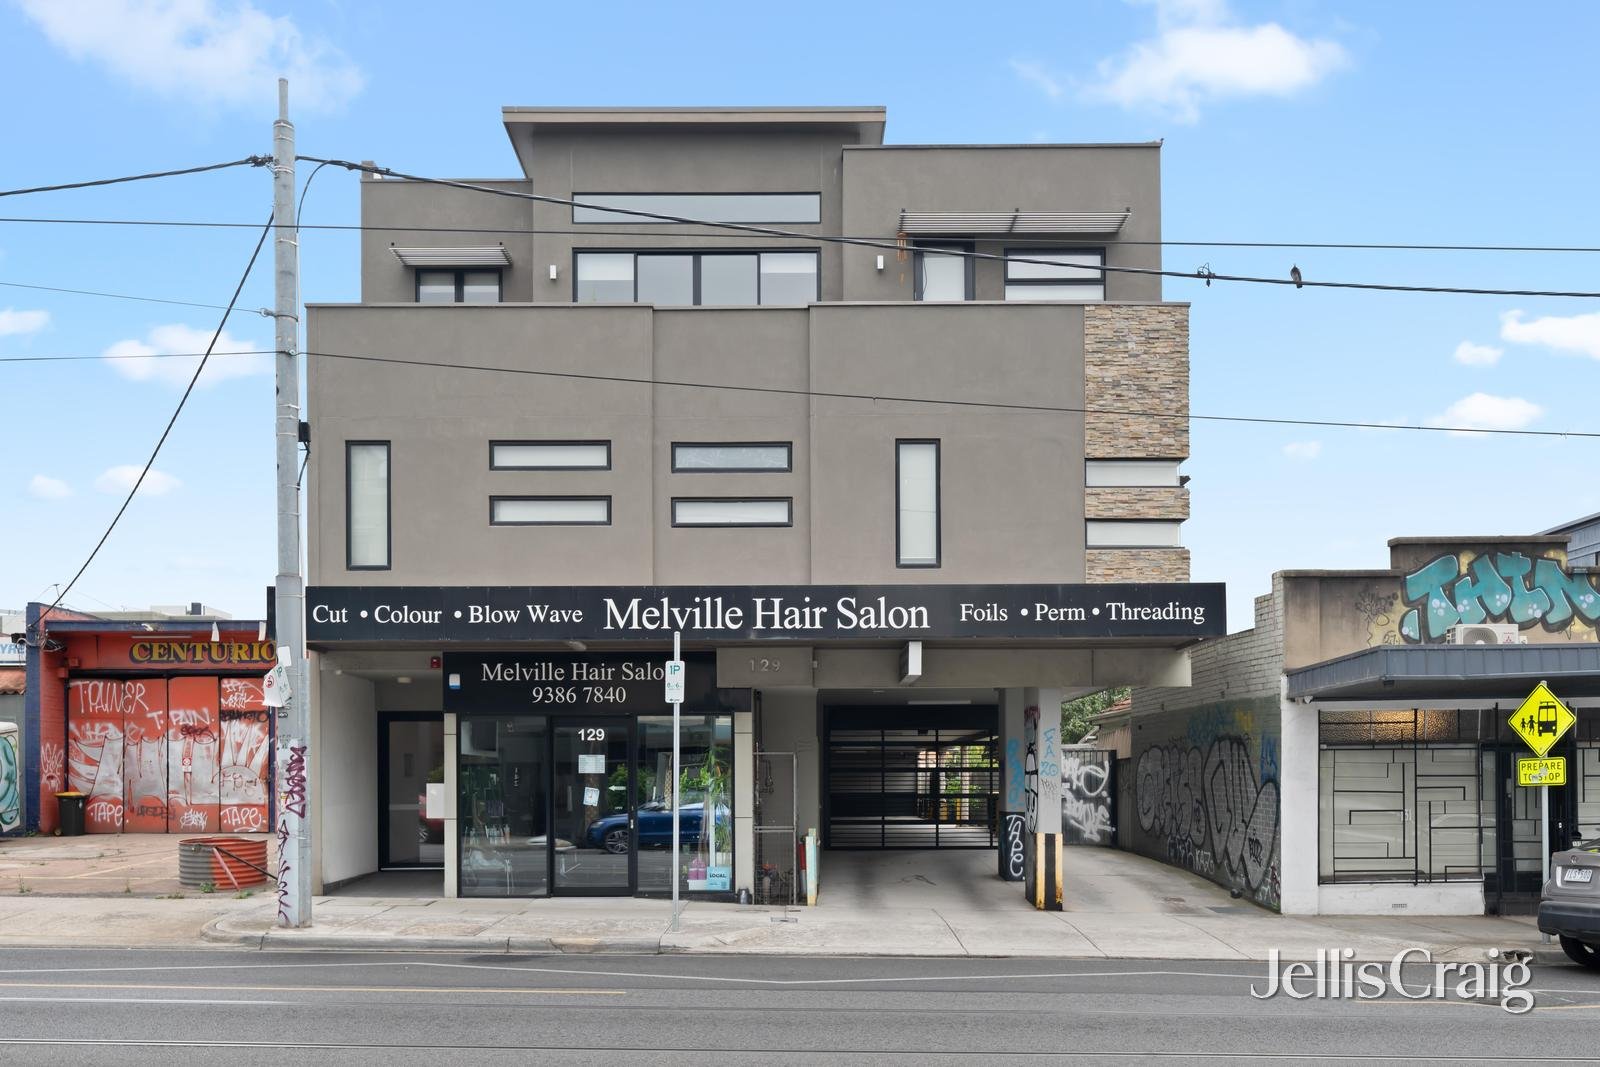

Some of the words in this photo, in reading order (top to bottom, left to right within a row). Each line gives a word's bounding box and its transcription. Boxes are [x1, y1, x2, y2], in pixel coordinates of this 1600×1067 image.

[312, 604, 348, 624] Cut
[374, 604, 442, 624] Colour
[468, 604, 520, 624] Blow
[526, 604, 583, 624] Wave
[602, 596, 744, 630] Melville
[752, 596, 827, 630] Hair
[836, 596, 930, 630] Salon
[959, 603, 1008, 622] Foils
[1034, 603, 1086, 622] Perm
[1106, 602, 1205, 625] Threading
[131, 639, 276, 664] CENTURIO
[481, 662, 565, 681] Melville
[571, 662, 615, 681] Hair
[621, 662, 664, 681] Salo
[749, 658, 781, 671] 129
[531, 686, 577, 704] 9386
[582, 686, 627, 704] 7840
[578, 728, 605, 741] 129
[1521, 760, 1562, 771] PREPARE
